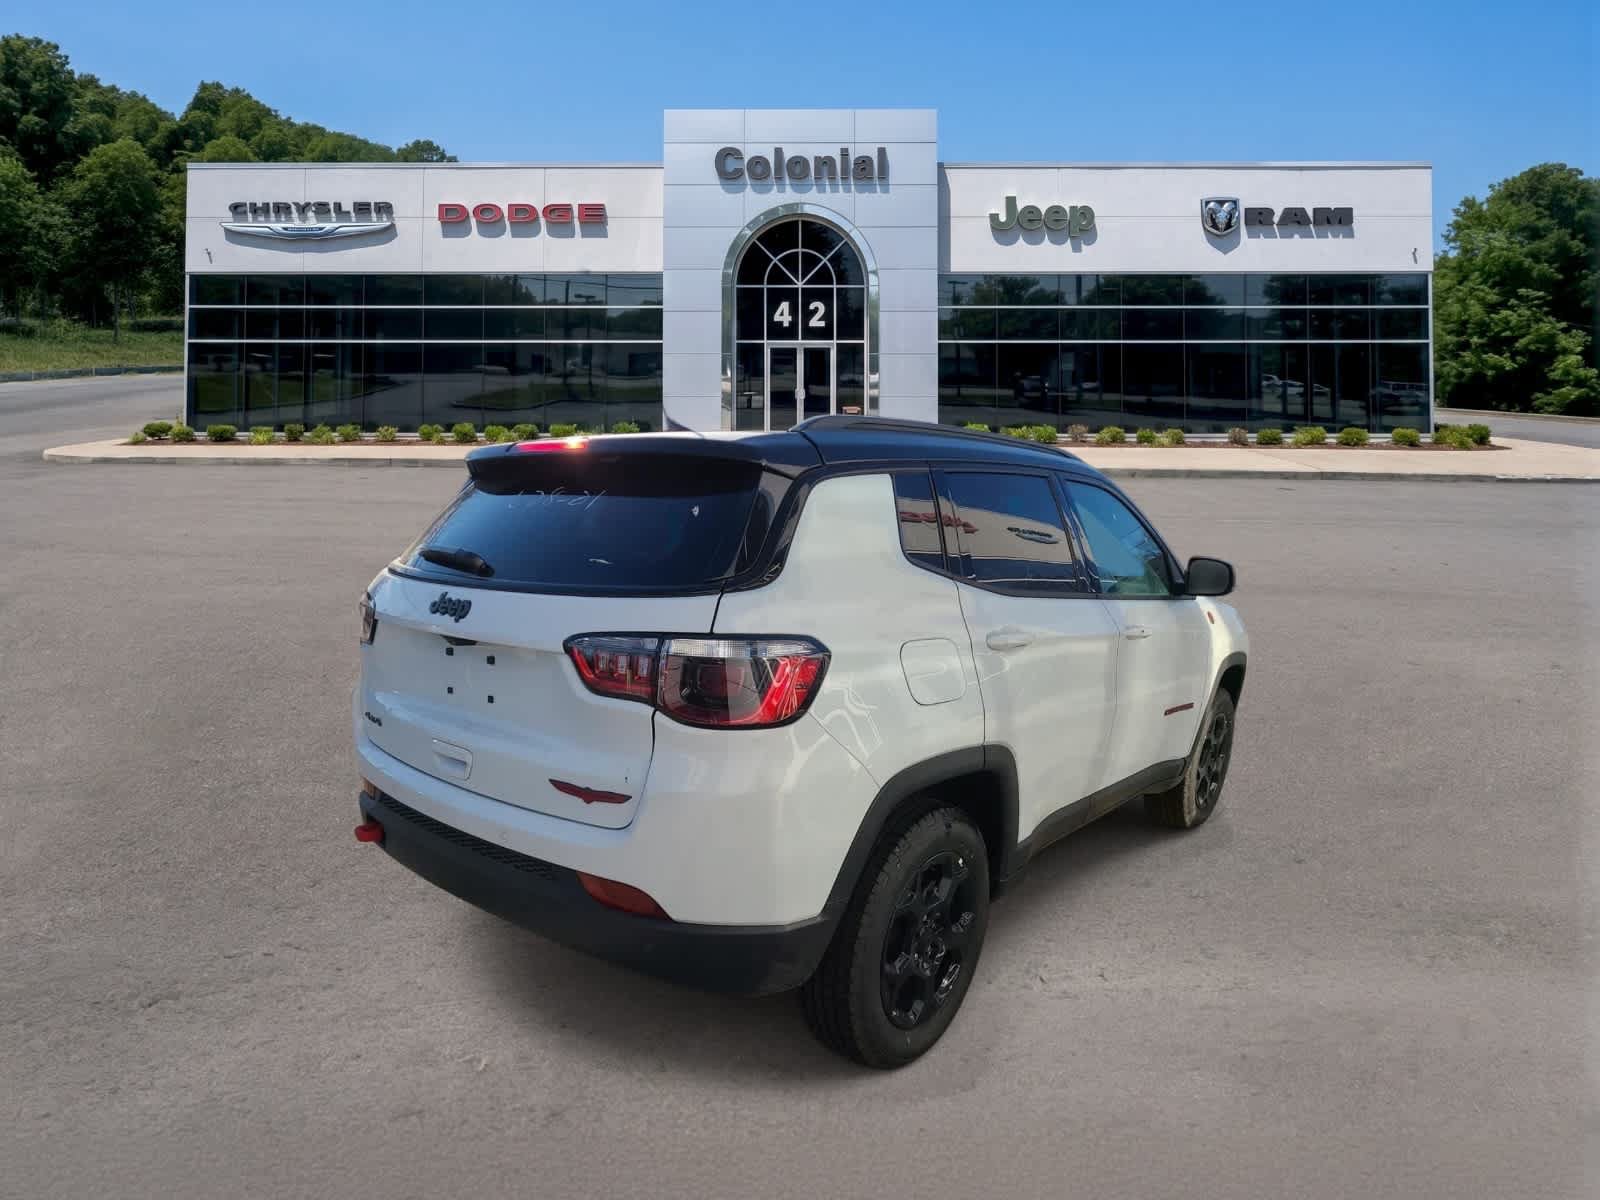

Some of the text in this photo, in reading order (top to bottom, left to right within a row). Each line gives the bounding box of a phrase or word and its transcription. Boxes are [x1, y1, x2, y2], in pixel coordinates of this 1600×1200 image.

[715, 146, 888, 180] Colonial
[228, 201, 394, 216] CHRYSLER
[438, 203, 606, 223] DODGE
[989, 195, 1095, 238] Jeep
[1244, 207, 1354, 226] RAM
[773, 301, 826, 327] 4 2
[429, 591, 472, 623] Jeep
